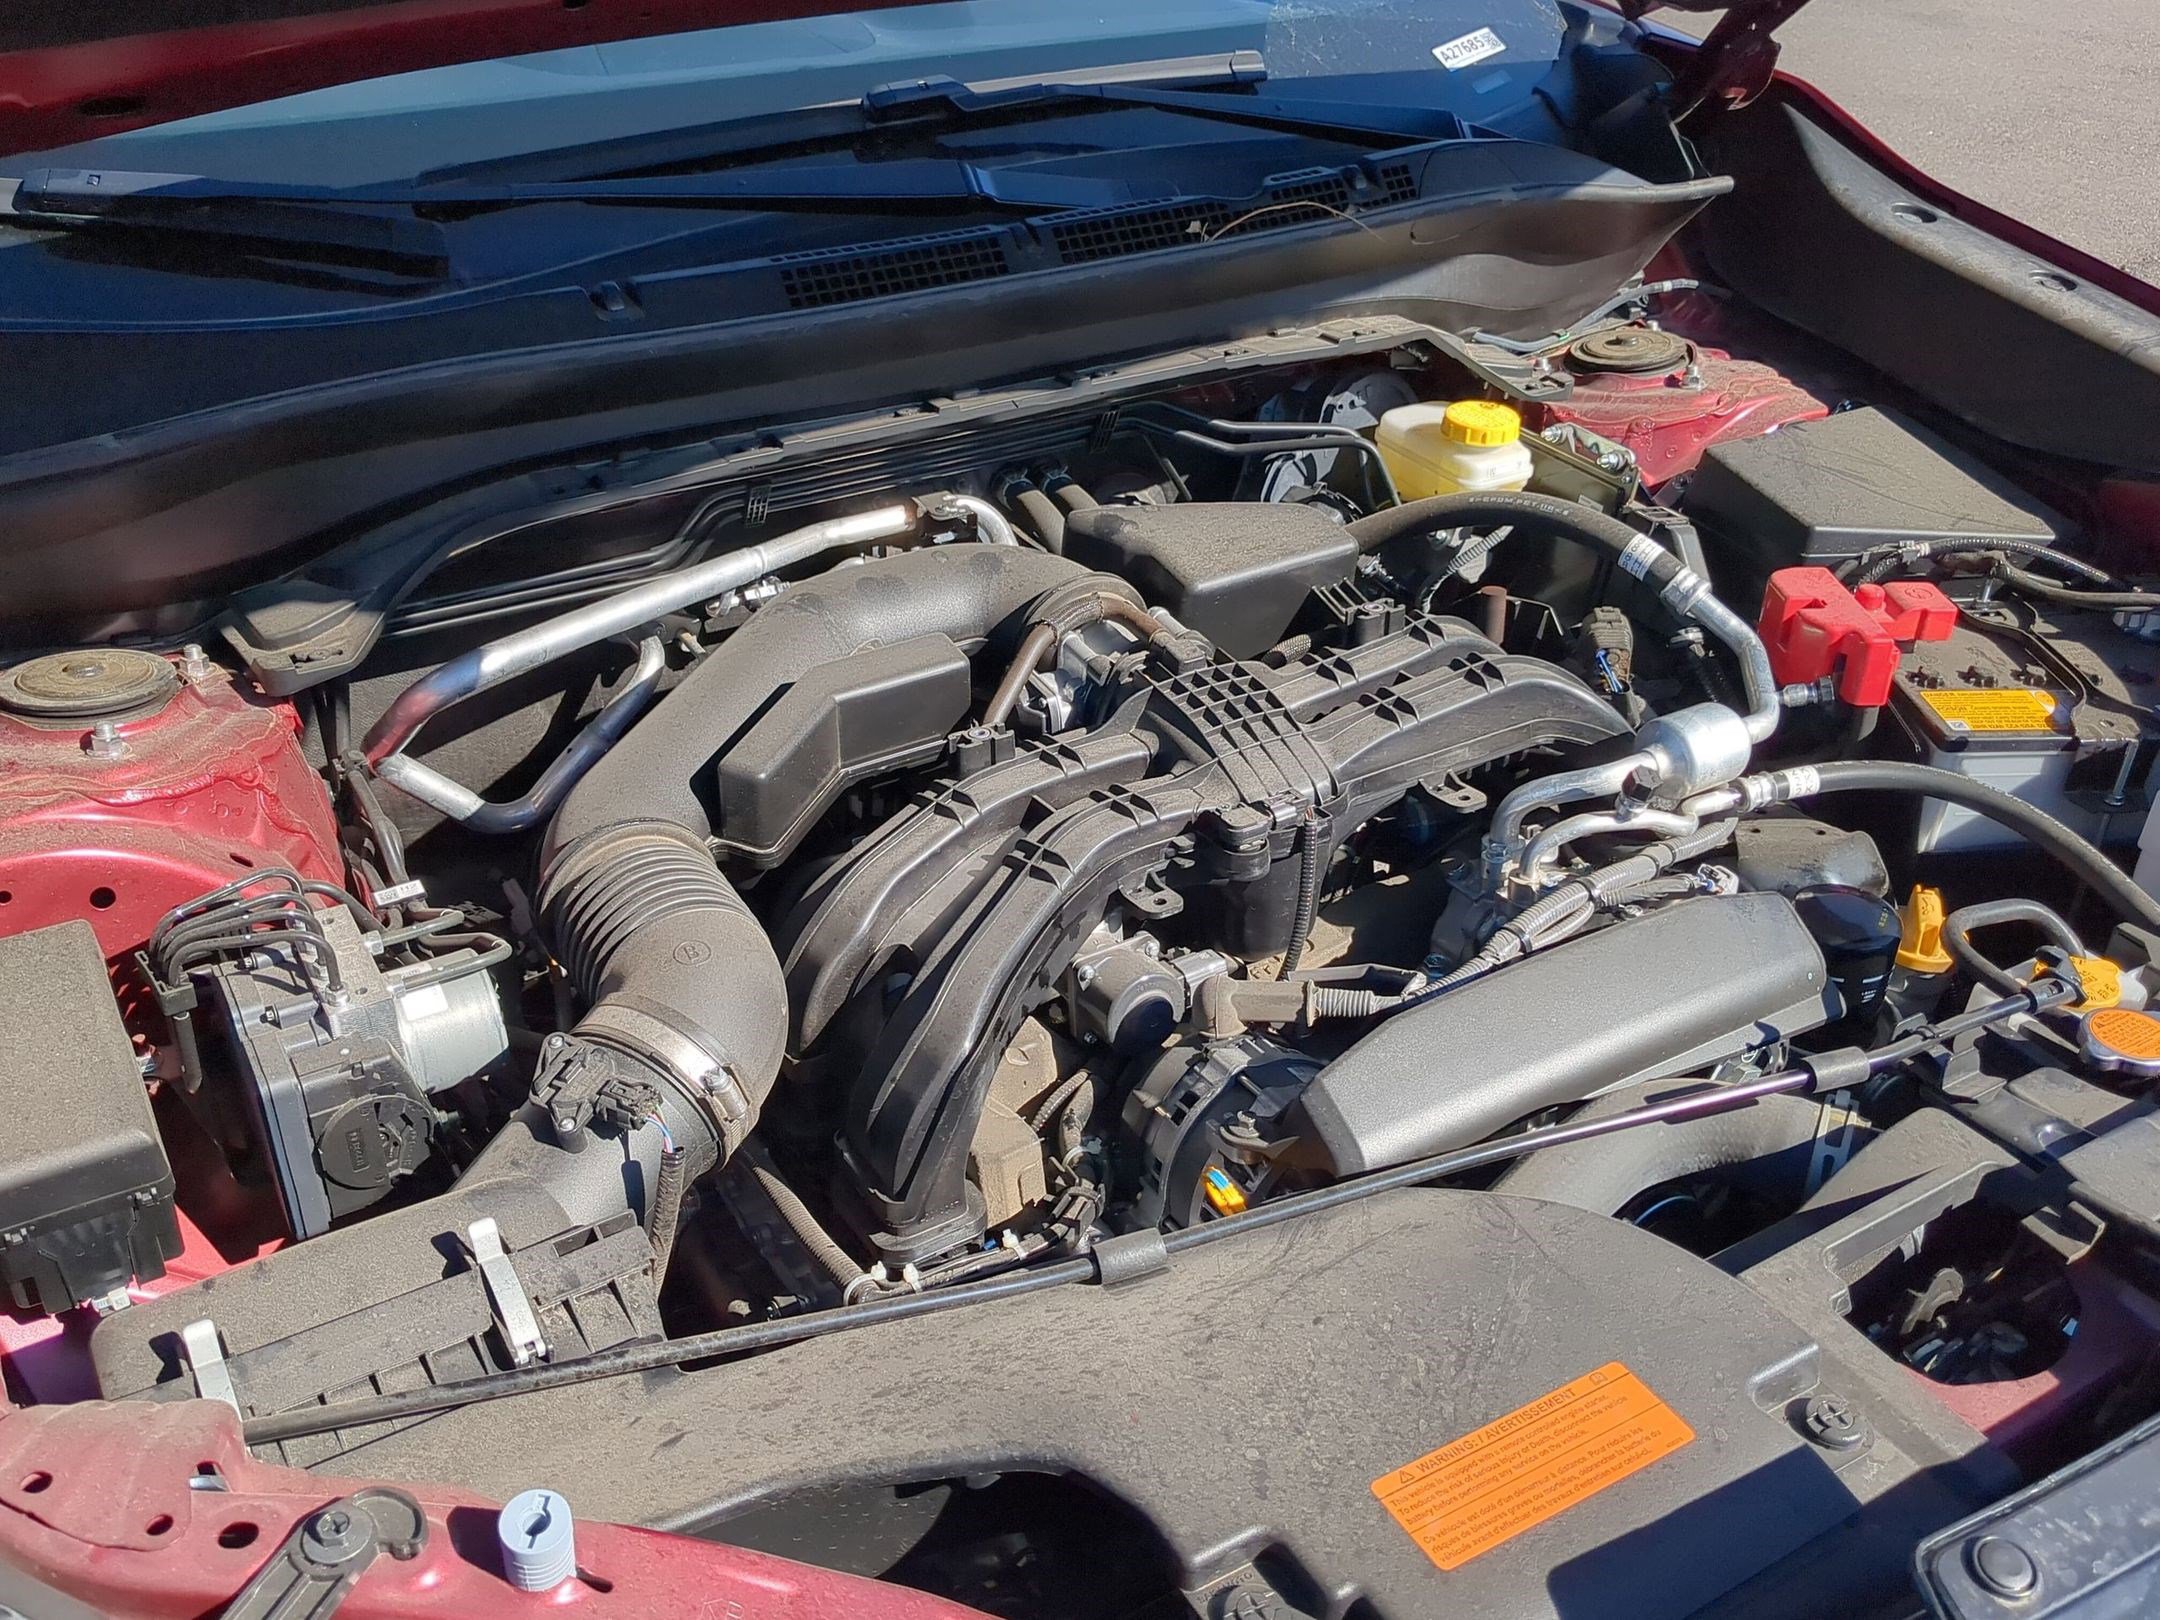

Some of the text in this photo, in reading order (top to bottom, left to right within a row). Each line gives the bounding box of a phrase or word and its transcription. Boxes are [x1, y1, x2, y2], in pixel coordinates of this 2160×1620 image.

[1440, 36, 1485, 62] A27685
[1407, 1480, 1436, 1499] vehicle
[1442, 1459, 1480, 1482] equipped
[1522, 1417, 1562, 1440] controlled
[1559, 1405, 1587, 1423] engine
[1407, 1492, 1437, 1511] reduce
[1434, 1486, 1450, 1497] the
[1447, 1479, 1464, 1491] risk
[1471, 1460, 1501, 1478] serious
[1551, 1413, 1593, 1437] disconnect
[1589, 1407, 1604, 1418] the
[1414, 1436, 1479, 1473] WARNING:
[1481, 1387, 1578, 1440] AVERTISSEMENT
[1404, 1506, 1437, 1527] battery
[1432, 1494, 1459, 1511] before
[1457, 1474, 1500, 1500] performing
[1496, 1467, 1514, 1479] any
[1511, 1453, 1539, 1470] service
[1463, 1509, 1481, 1522] est
[1504, 1495, 1535, 1516] graves
